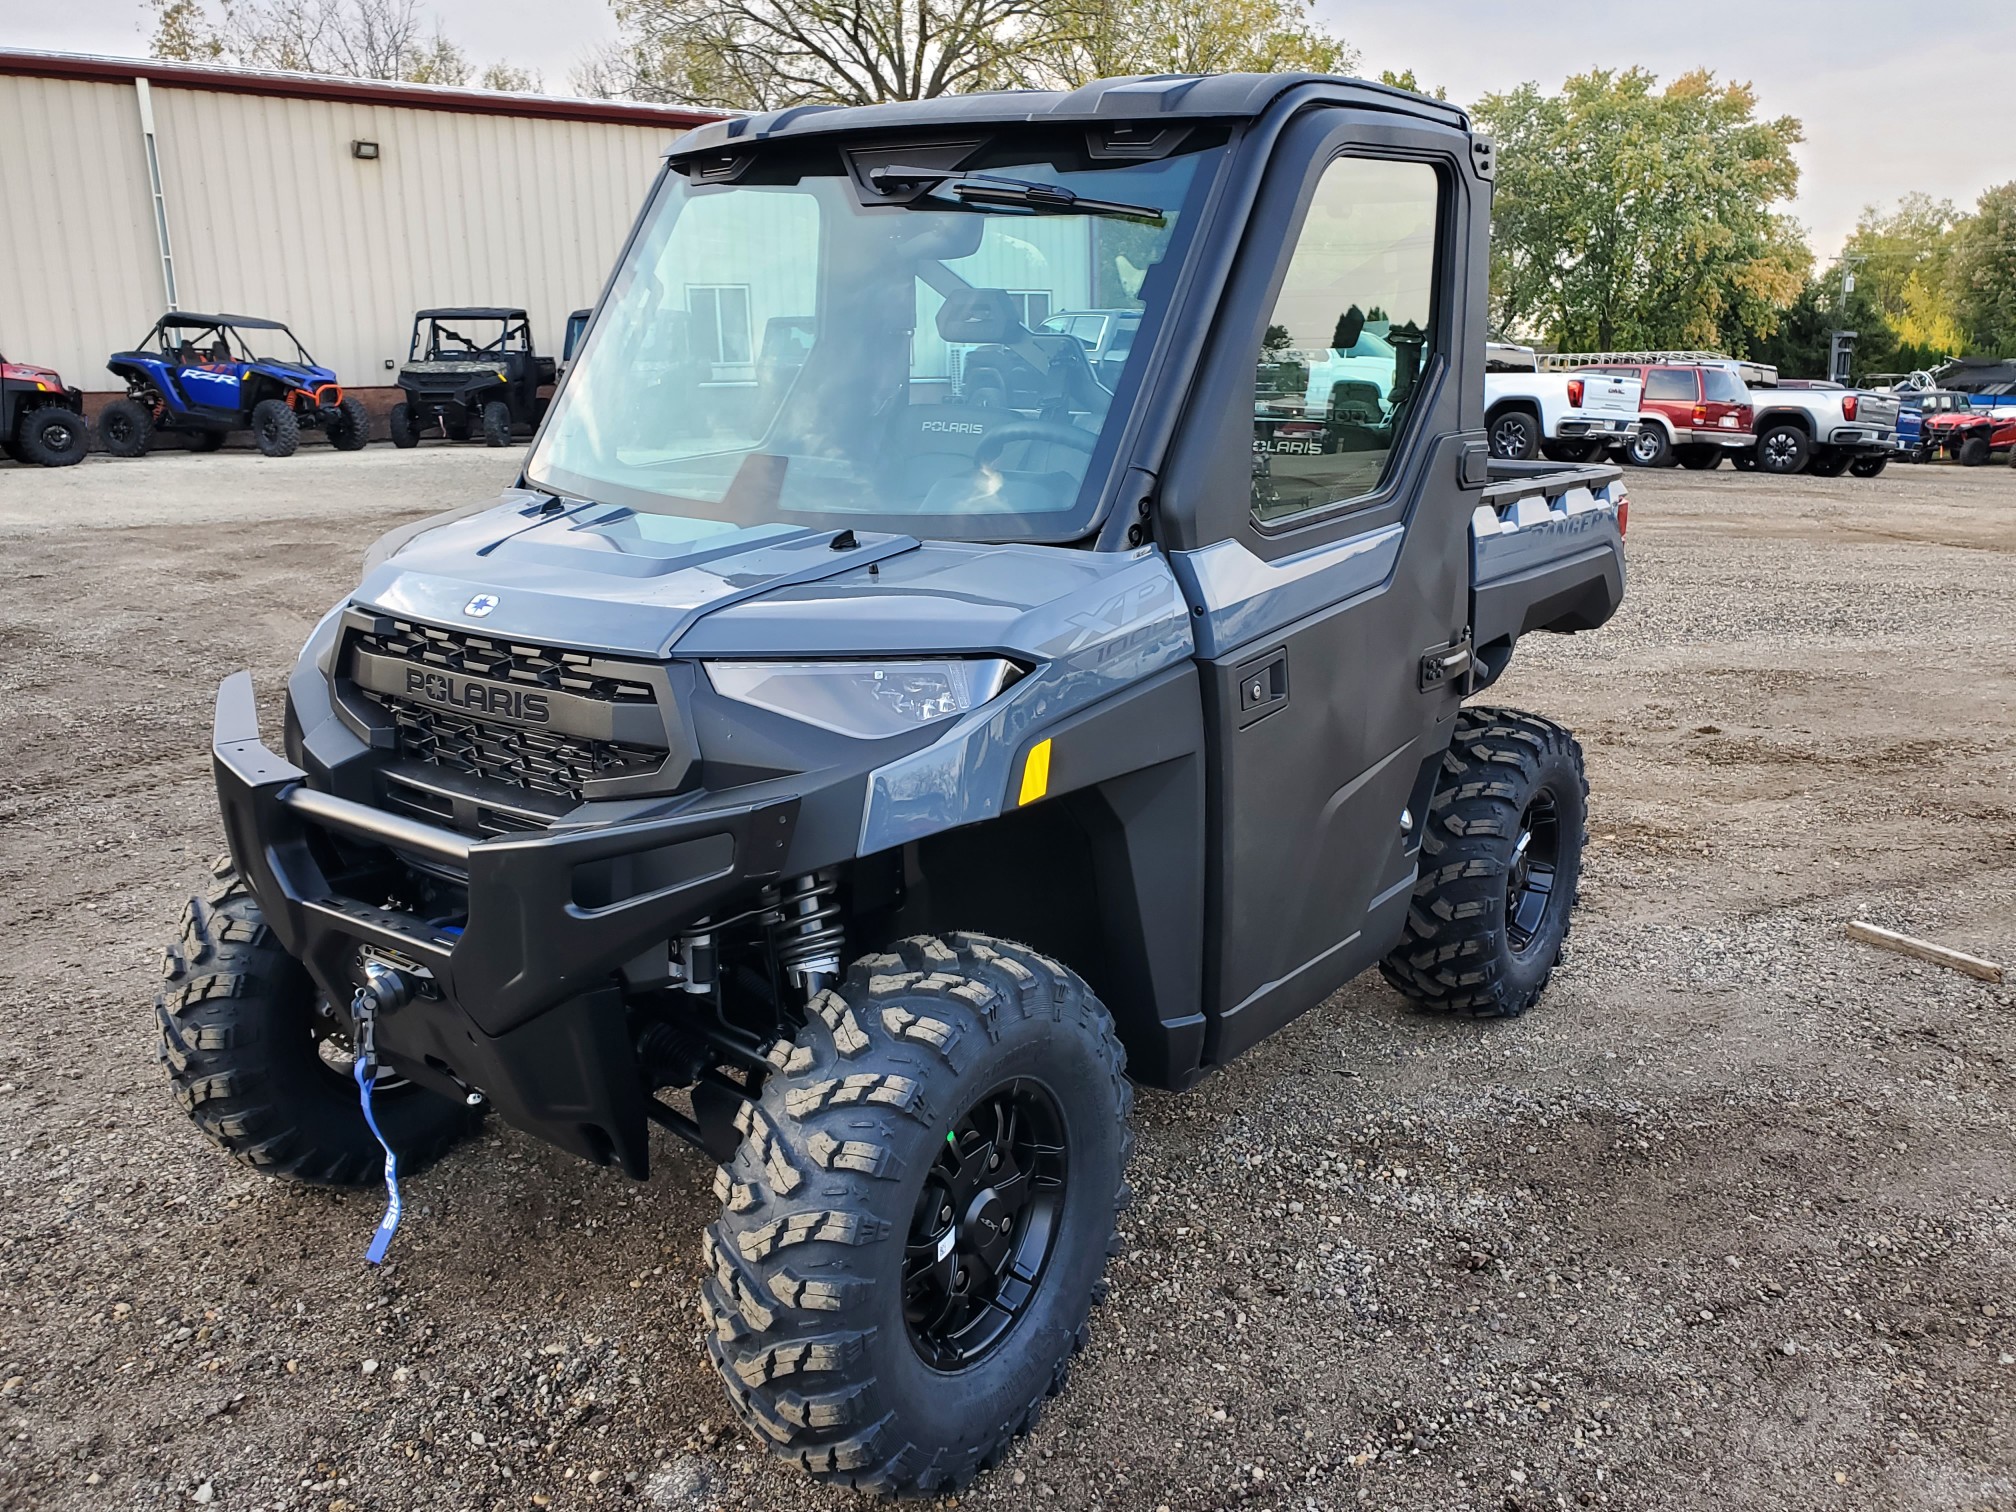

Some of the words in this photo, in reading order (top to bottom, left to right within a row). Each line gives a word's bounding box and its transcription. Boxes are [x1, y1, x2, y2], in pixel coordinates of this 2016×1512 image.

[181, 369, 238, 385] RZR
[921, 421, 984, 435] POLARIS
[1252, 440, 1323, 455] OLARIS
[1064, 574, 1175, 652] XP
[405, 667, 551, 725] POLARIS
[382, 1151, 399, 1230] OLARIS
